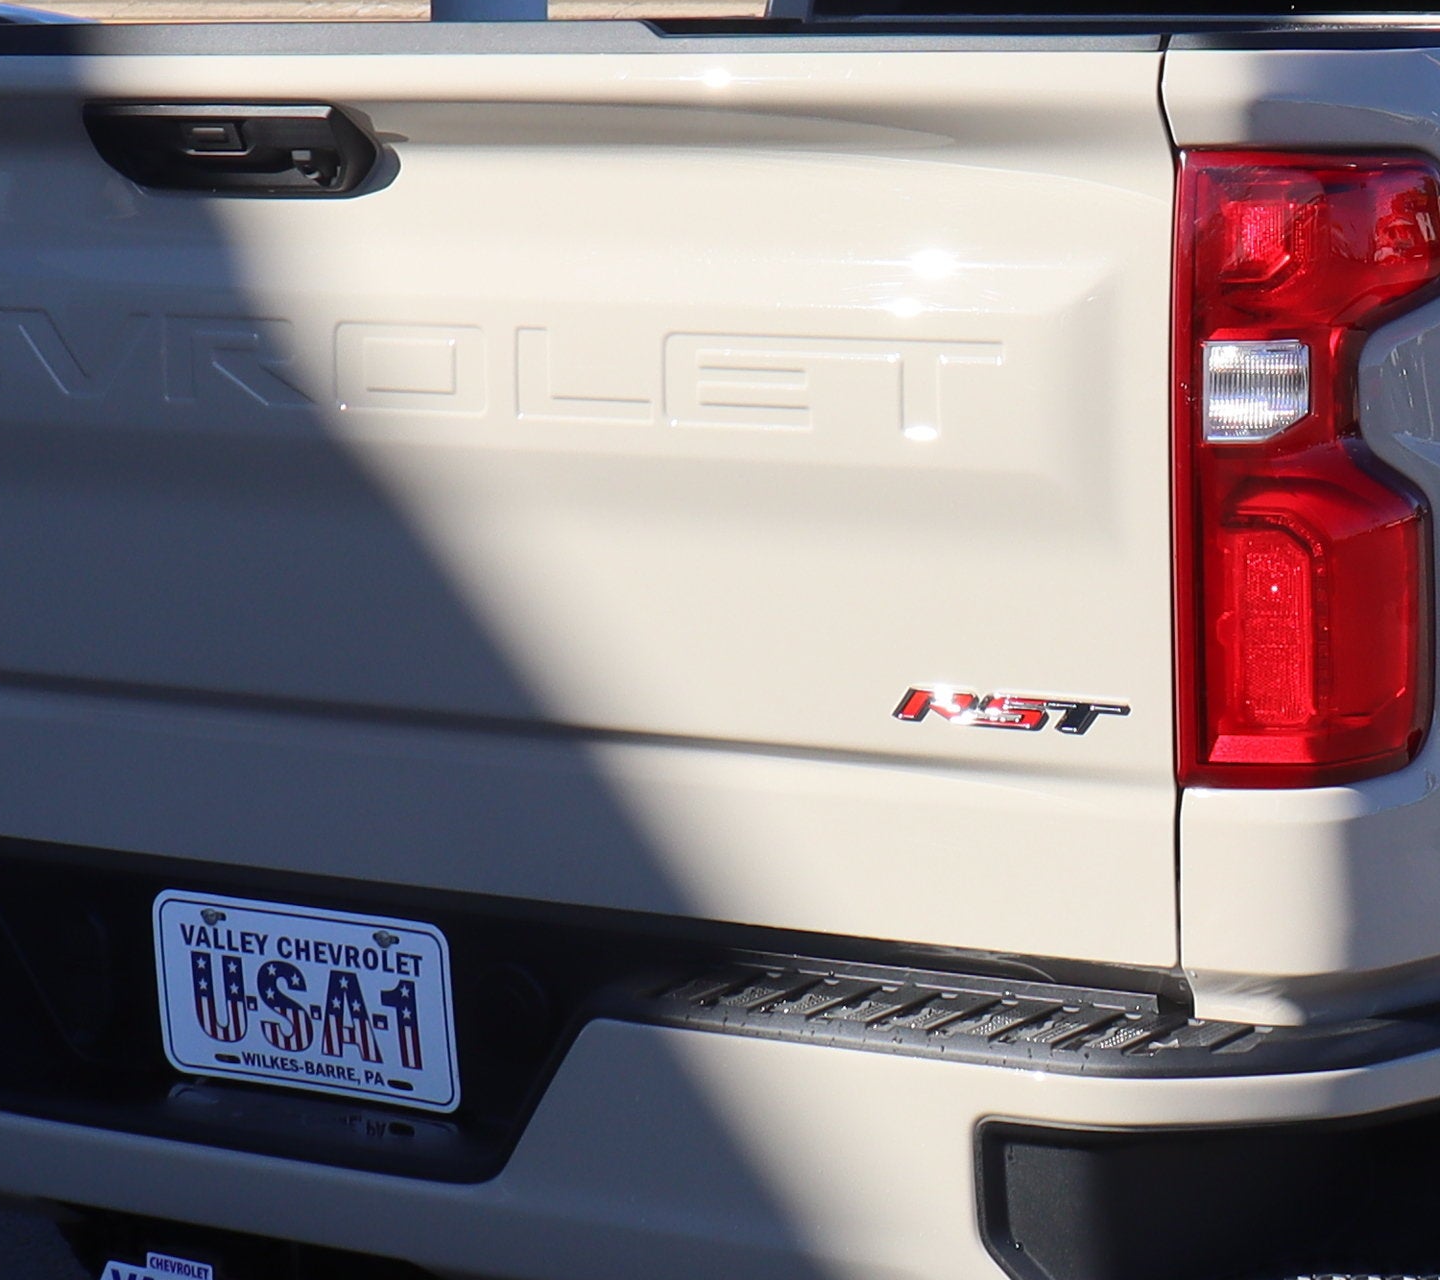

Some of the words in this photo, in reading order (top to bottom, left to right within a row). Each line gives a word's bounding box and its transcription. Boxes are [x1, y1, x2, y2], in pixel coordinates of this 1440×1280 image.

[891, 683, 1132, 736] RST
[179, 923, 269, 957] VALLEY
[276, 936, 424, 978] CHEVROLET
[242, 1051, 362, 1086] WILKES-BARRE,
[365, 1070, 385, 1088] PA
[149, 1256, 211, 1280] CHEVROLET
